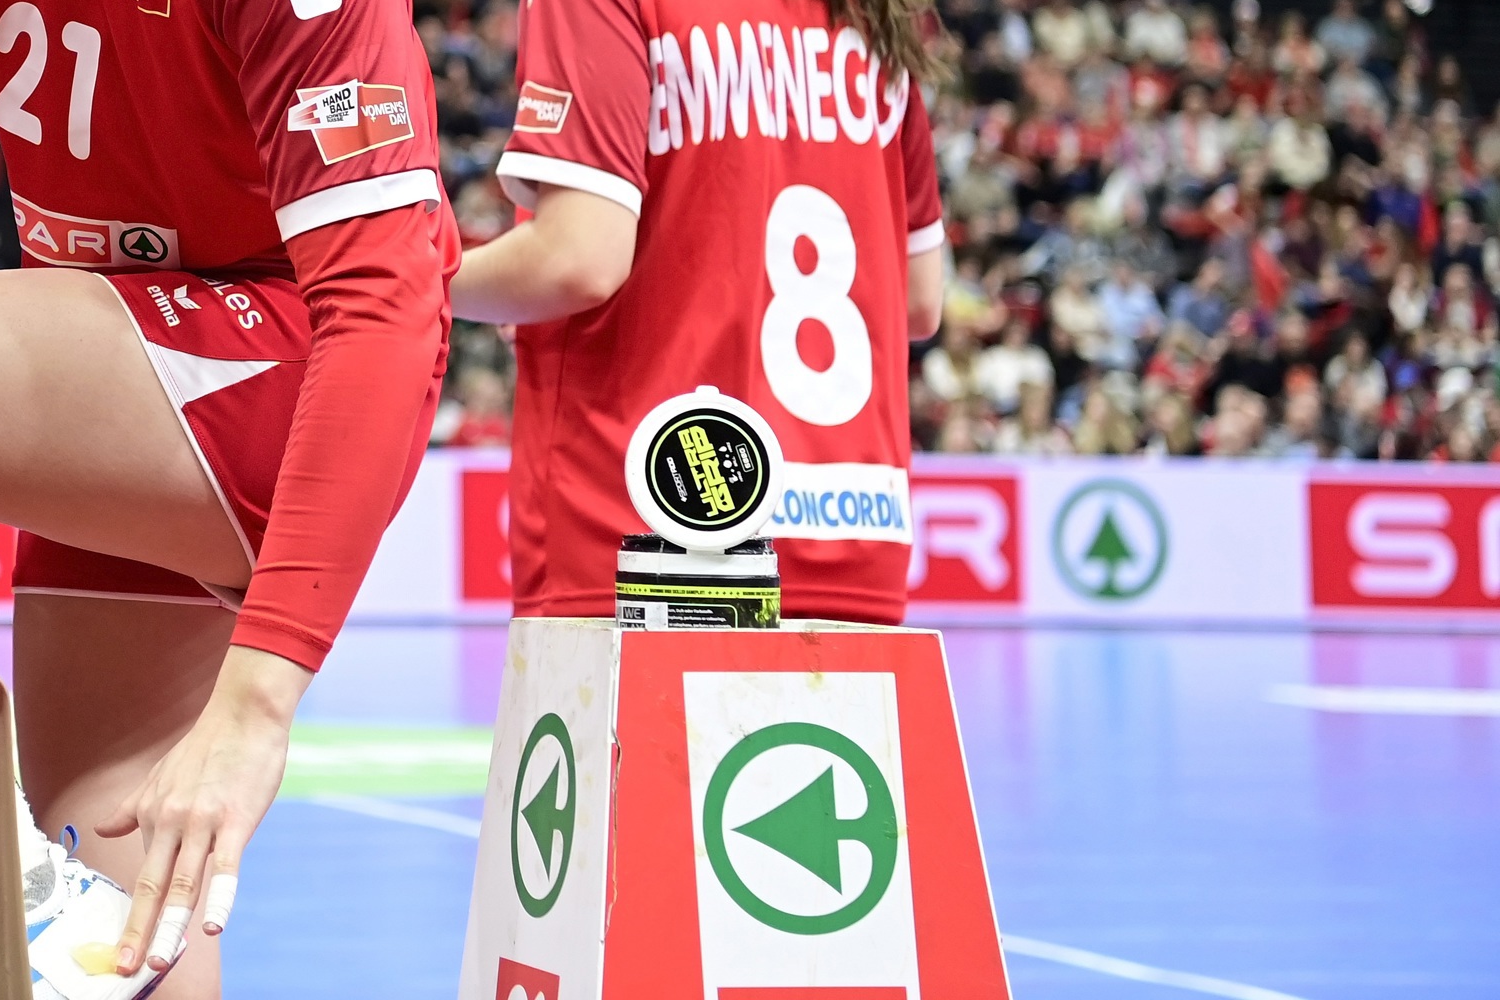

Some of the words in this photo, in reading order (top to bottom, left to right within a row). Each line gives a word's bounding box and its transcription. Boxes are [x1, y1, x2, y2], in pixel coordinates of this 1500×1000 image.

[322, 87, 352, 108] HAND
[329, 102, 356, 115] BALL
[389, 112, 407, 126] DAY
[146, 284, 181, 328] erima
[760, 184, 874, 427] 8
[677, 428, 719, 517] ULTRA
[689, 425, 736, 513] GRIP
[623, 608, 642, 620] WE
